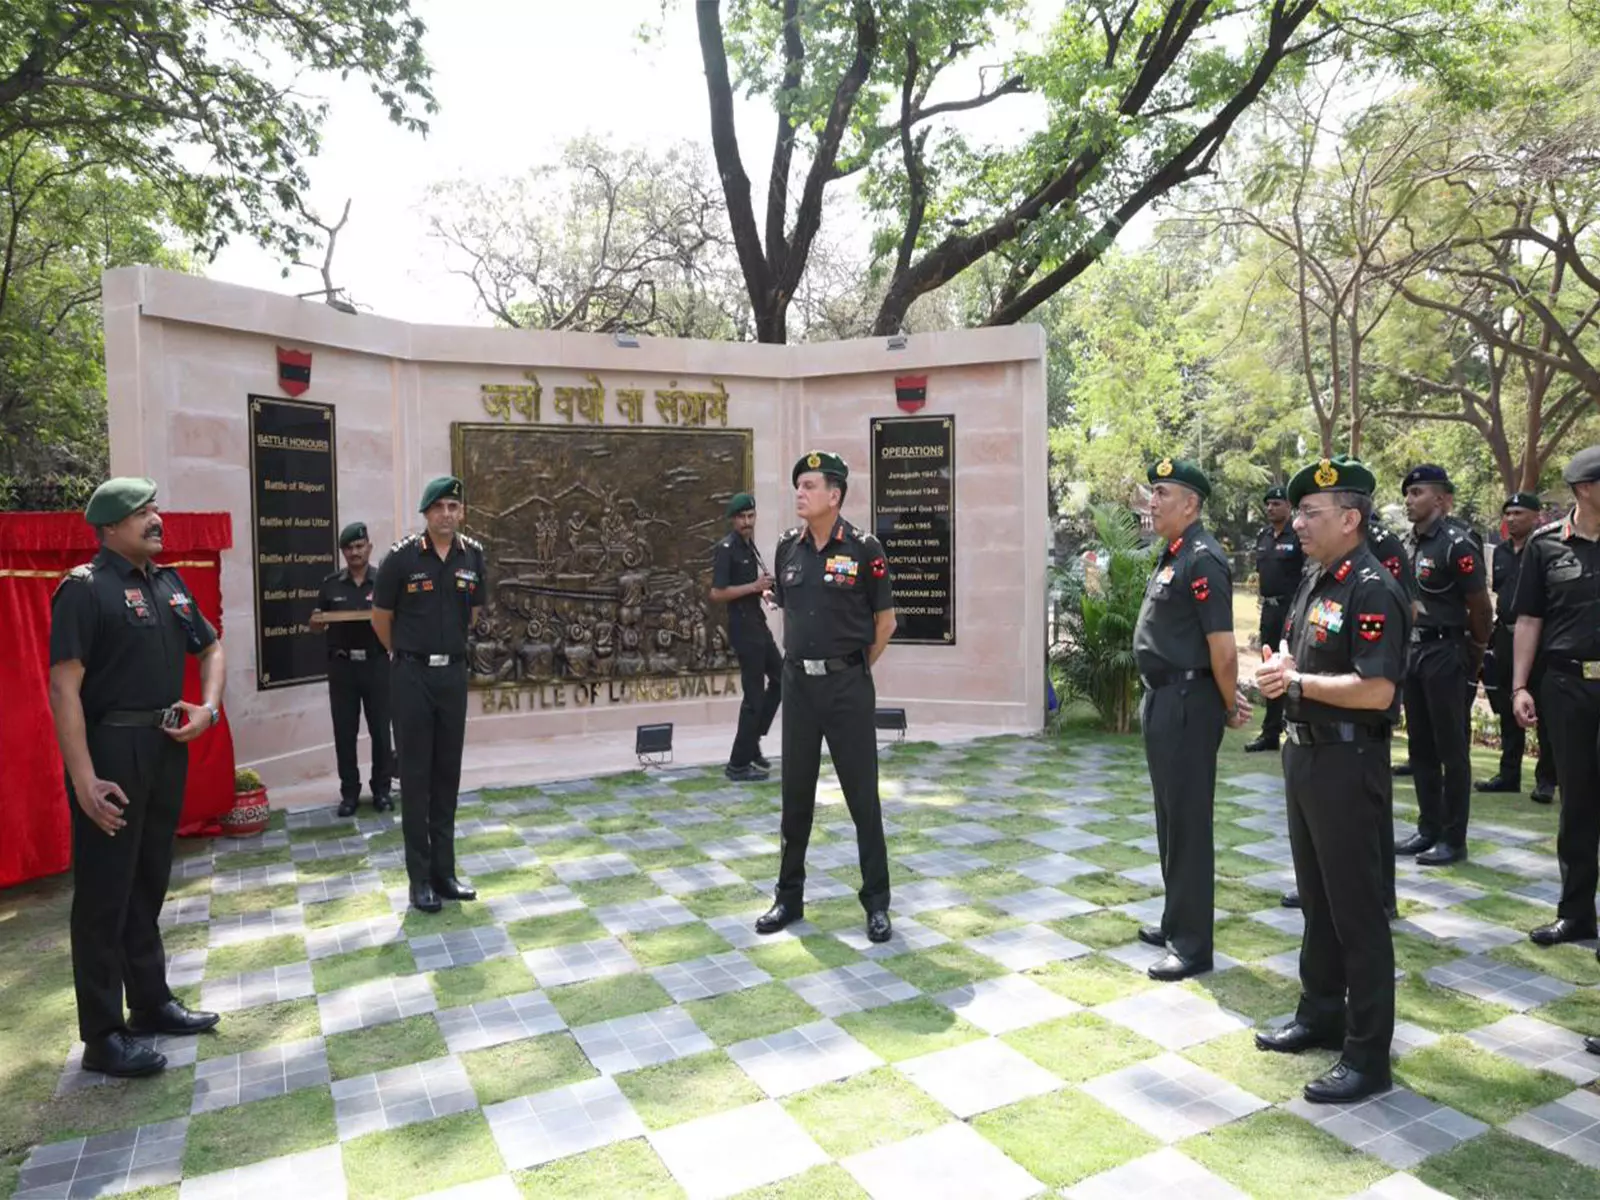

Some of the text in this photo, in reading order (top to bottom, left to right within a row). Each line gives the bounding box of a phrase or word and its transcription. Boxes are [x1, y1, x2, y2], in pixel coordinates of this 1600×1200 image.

[257, 434, 329, 451] BATTLE HONOURS
[882, 445, 944, 458] OPERATIONS
[264, 480, 326, 493] Battle of Rajouri
[886, 488, 921, 498] Hyderabad
[877, 505, 909, 514] Liberation
[910, 505, 917, 513] of
[260, 516, 283, 527] Battle
[284, 517, 293, 527] of
[312, 518, 330, 527] Uttar
[893, 522, 914, 530] Kutch
[886, 539, 896, 548] Op
[897, 539, 922, 547] RIDDLE
[260, 553, 283, 563] Battle
[284, 553, 293, 562] of
[888, 555, 949, 564] CACTUS LILY 1971
[897, 573, 922, 581] PAWAN
[264, 590, 287, 600] Battle
[288, 590, 297, 599] of
[891, 589, 930, 598] PARAKRAM
[264, 626, 288, 637] Battle
[289, 625, 297, 634] of
[482, 674, 738, 714] BATTLE OF LONGEWALA
